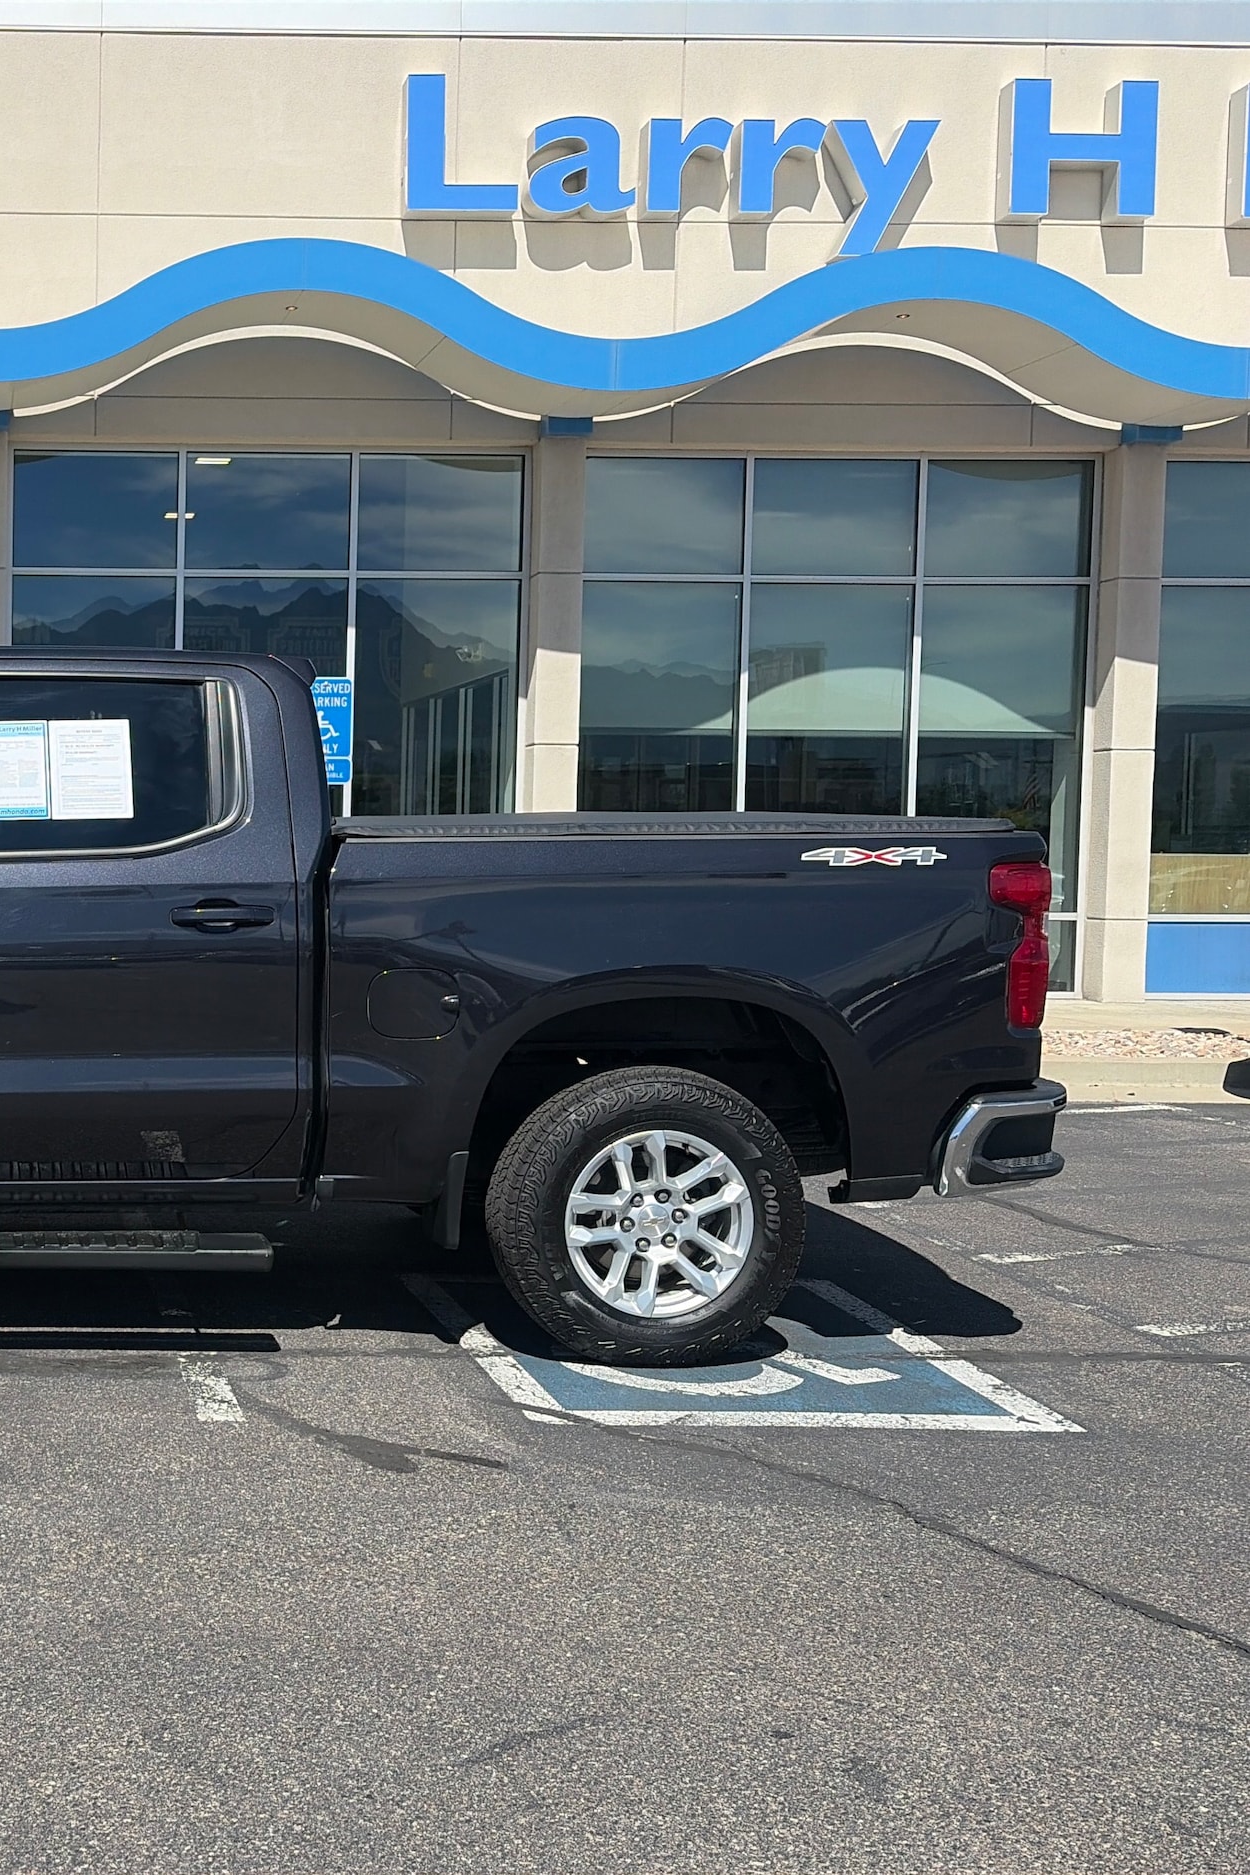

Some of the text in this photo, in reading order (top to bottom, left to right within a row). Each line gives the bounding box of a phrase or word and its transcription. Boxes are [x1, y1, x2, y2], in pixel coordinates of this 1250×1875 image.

[404, 73, 941, 258] Larry
[1007, 78, 1159, 220] H
[314, 682, 351, 694] SERVED
[323, 743, 339, 754] NLY
